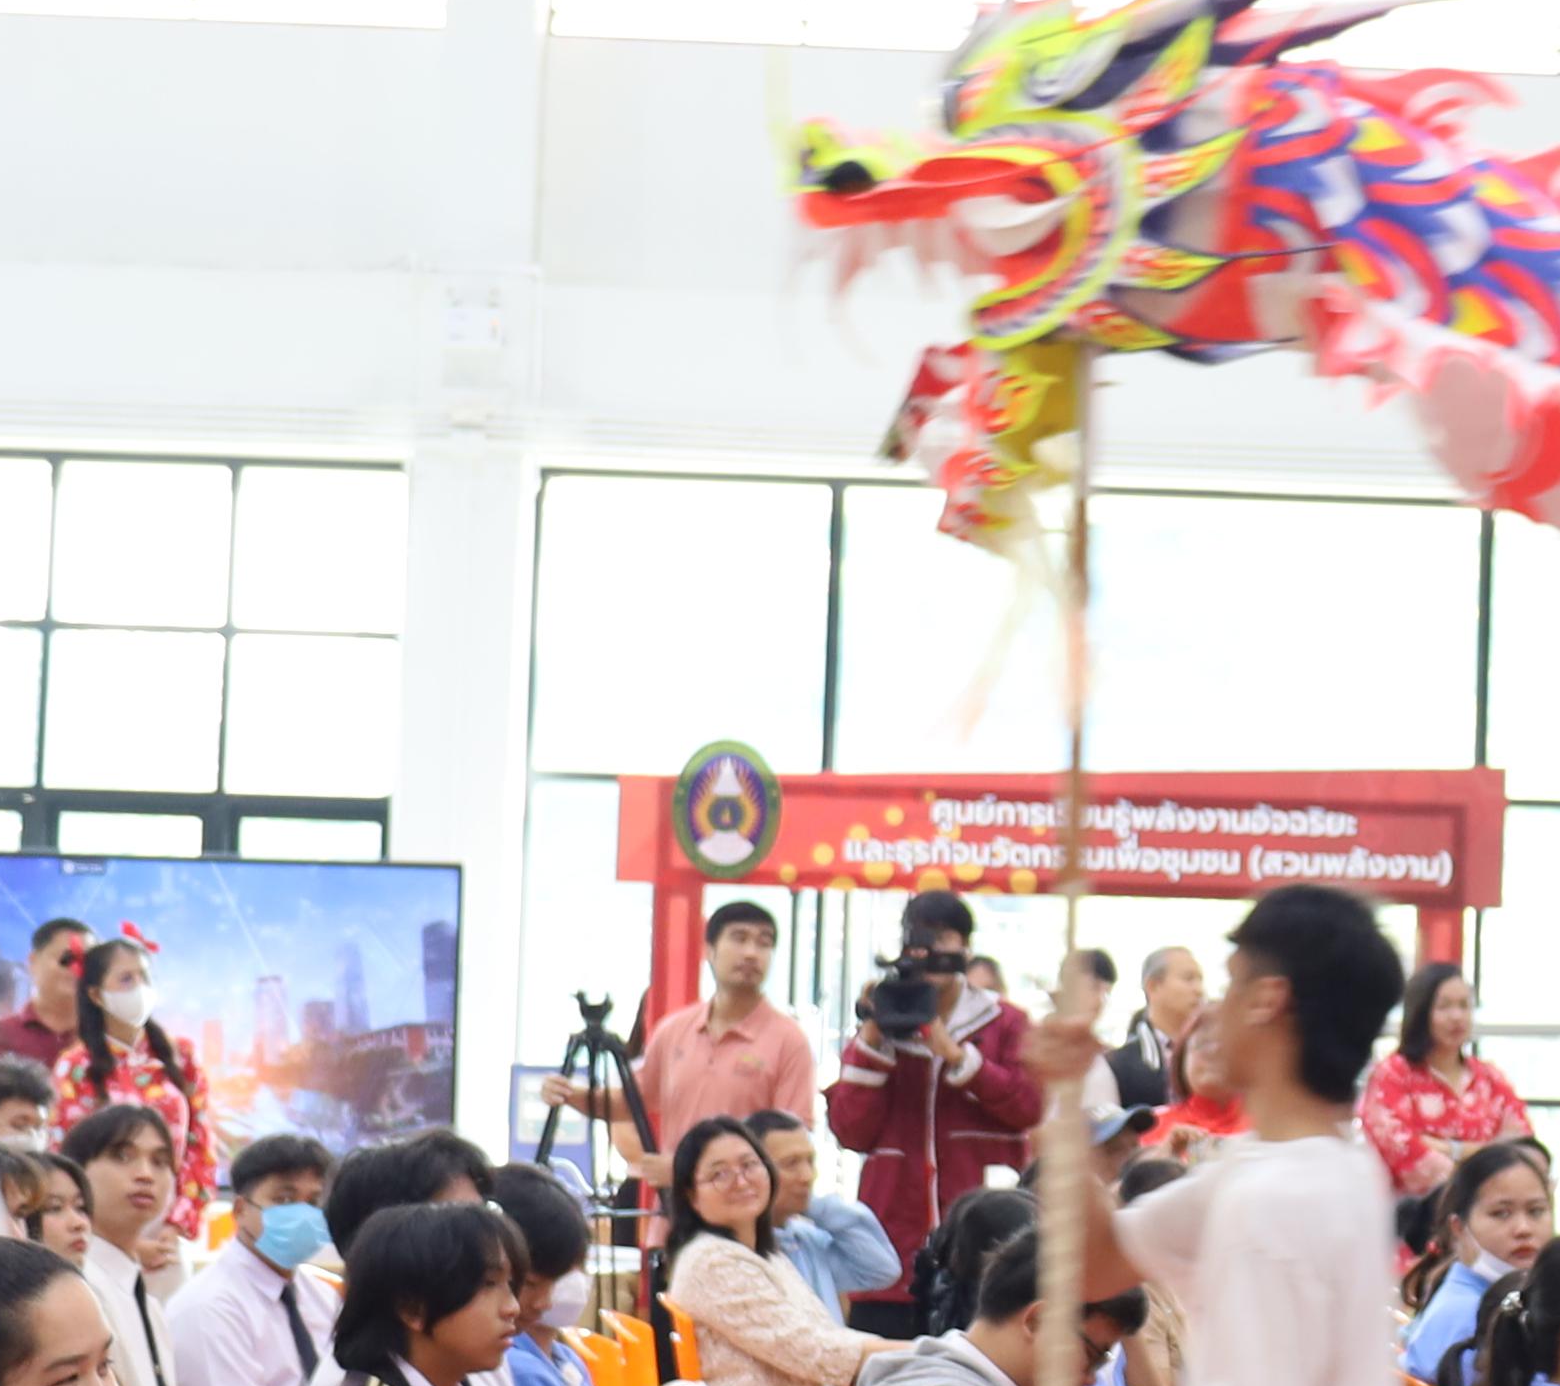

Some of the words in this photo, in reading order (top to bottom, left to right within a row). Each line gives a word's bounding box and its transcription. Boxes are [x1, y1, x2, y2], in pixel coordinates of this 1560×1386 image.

[844, 832, 1240, 883] และธุรกิจนวัตกรมเพื่อชุมชน
